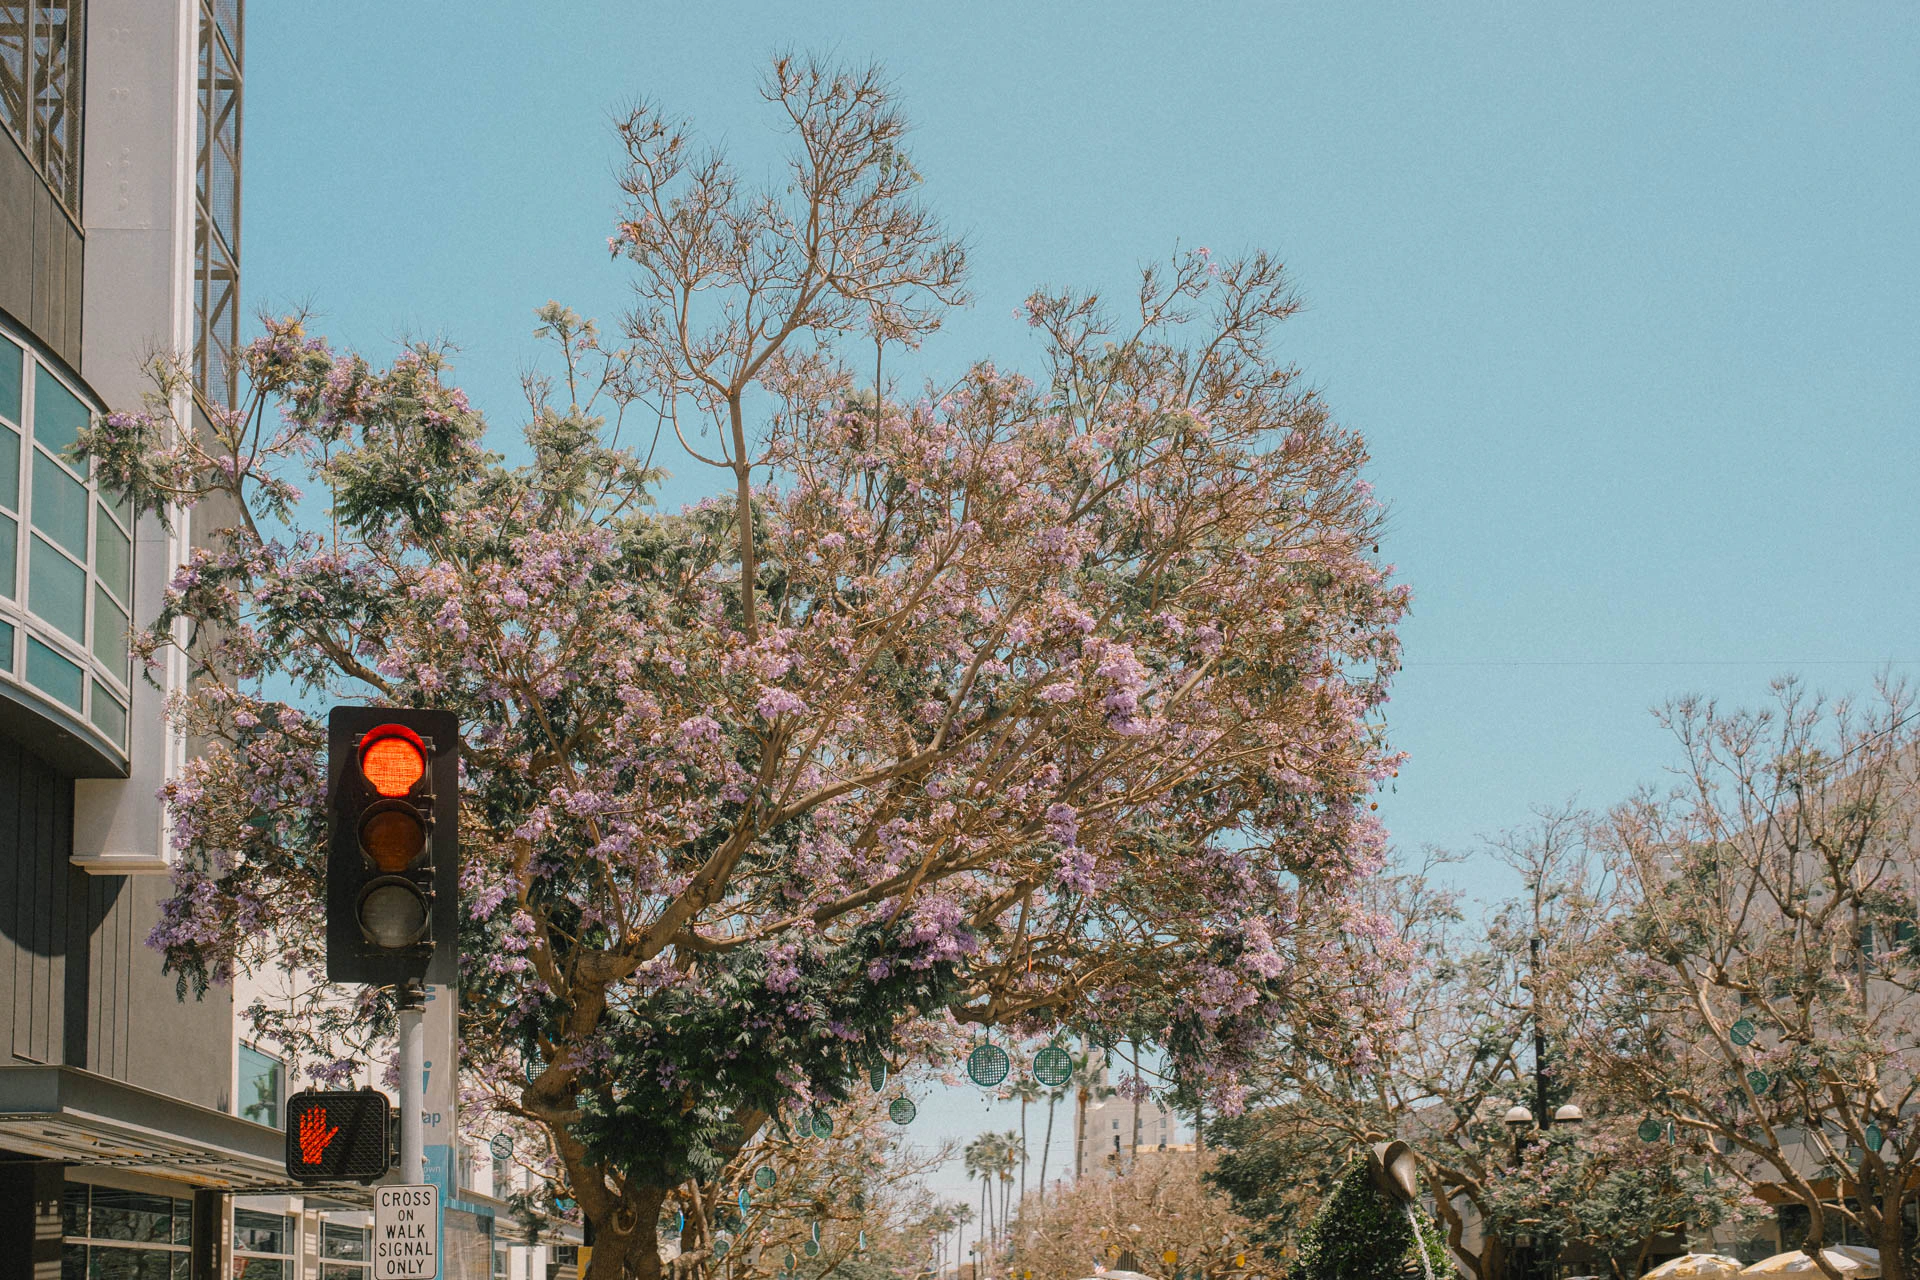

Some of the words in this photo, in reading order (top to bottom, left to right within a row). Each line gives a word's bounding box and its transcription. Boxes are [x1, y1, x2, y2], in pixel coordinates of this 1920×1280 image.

[422, 1112, 441, 1127] ap
[381, 1191, 431, 1207] CROSS
[398, 1209, 414, 1221] ON
[386, 1224, 425, 1239] WALK
[378, 1241, 433, 1257] SIGNAL
[387, 1259, 425, 1275] ONLY
